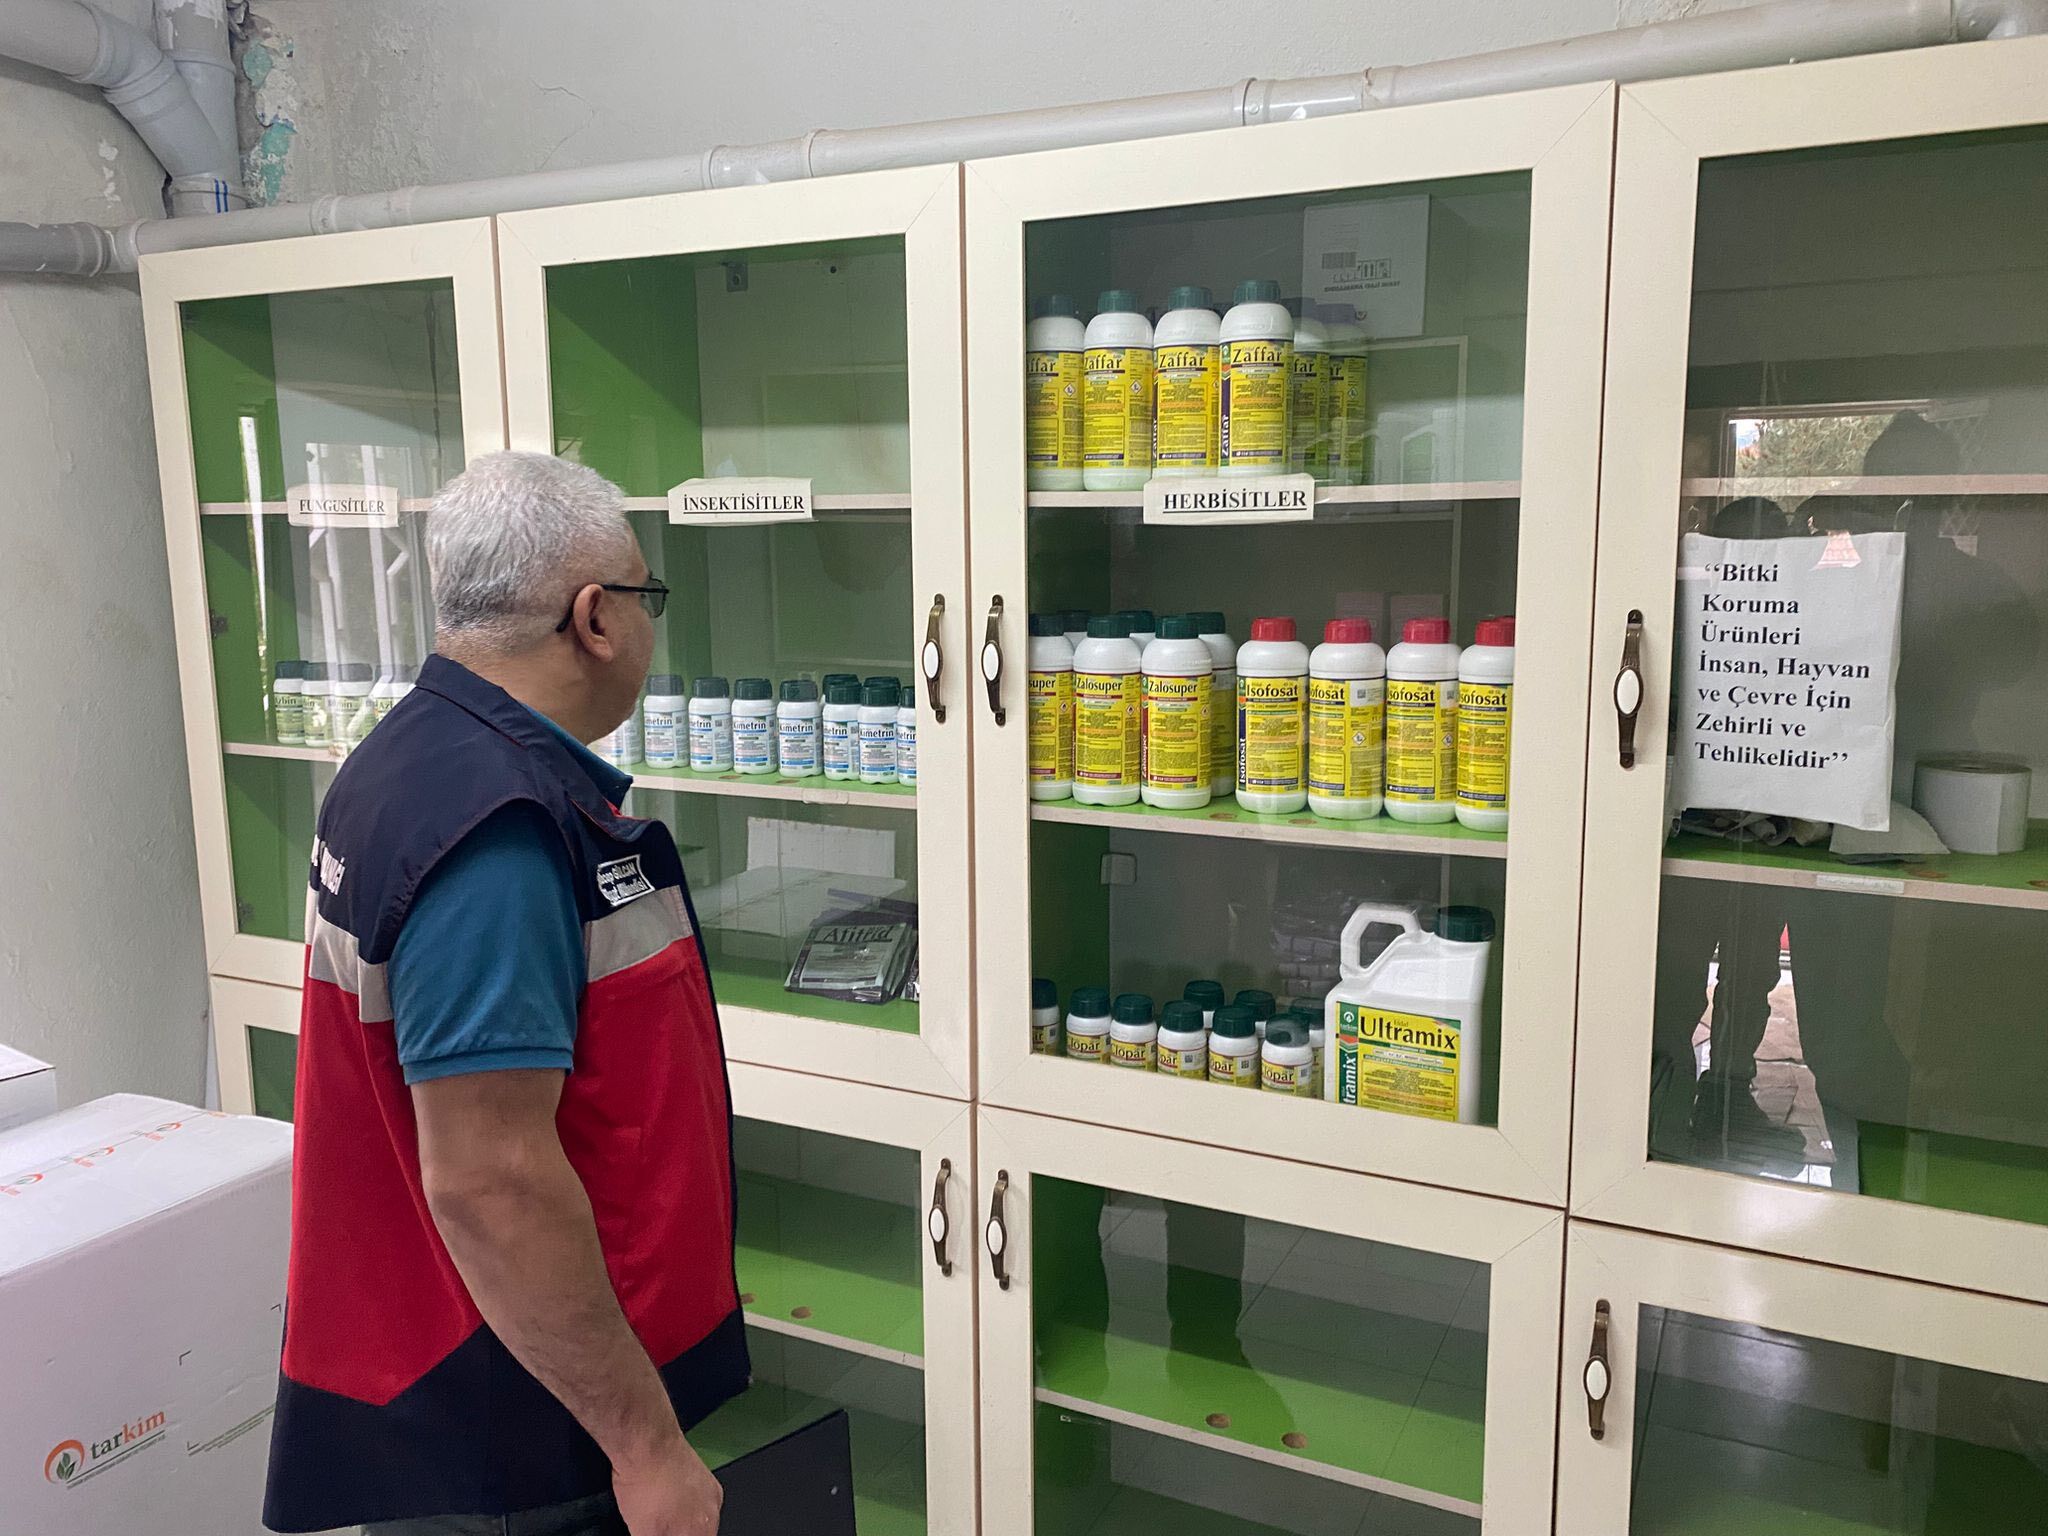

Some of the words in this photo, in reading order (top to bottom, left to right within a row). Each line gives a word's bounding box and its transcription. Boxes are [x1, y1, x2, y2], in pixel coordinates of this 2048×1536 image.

[1159, 351, 1206, 369] Zaffar
[1232, 347, 1283, 364] Zaffar
[683, 493, 804, 511] İNSEKTİSİTLER
[1164, 488, 1307, 510] HERBİSİTLER
[1701, 593, 1800, 614] Koruma
[1701, 620, 1801, 646] Ürünleri
[1698, 650, 1768, 678] İnsan,
[1777, 657, 1870, 682] Hayvan
[1029, 678, 1056, 692] super
[1076, 677, 1123, 695] Zalosuper
[1149, 680, 1198, 697] Zalosuper
[1247, 683, 1298, 698] Isofosat
[1698, 687, 1721, 702] ve
[1728, 685, 1797, 708] Çevre
[1805, 685, 1851, 712] İçin
[1695, 712, 1773, 736] Zehirli
[1781, 723, 1806, 737] ve
[1360, 1016, 1457, 1050] Ultramix
[1343, 1056, 1357, 1104] tramix
[91, 1411, 165, 1459] tarkim
